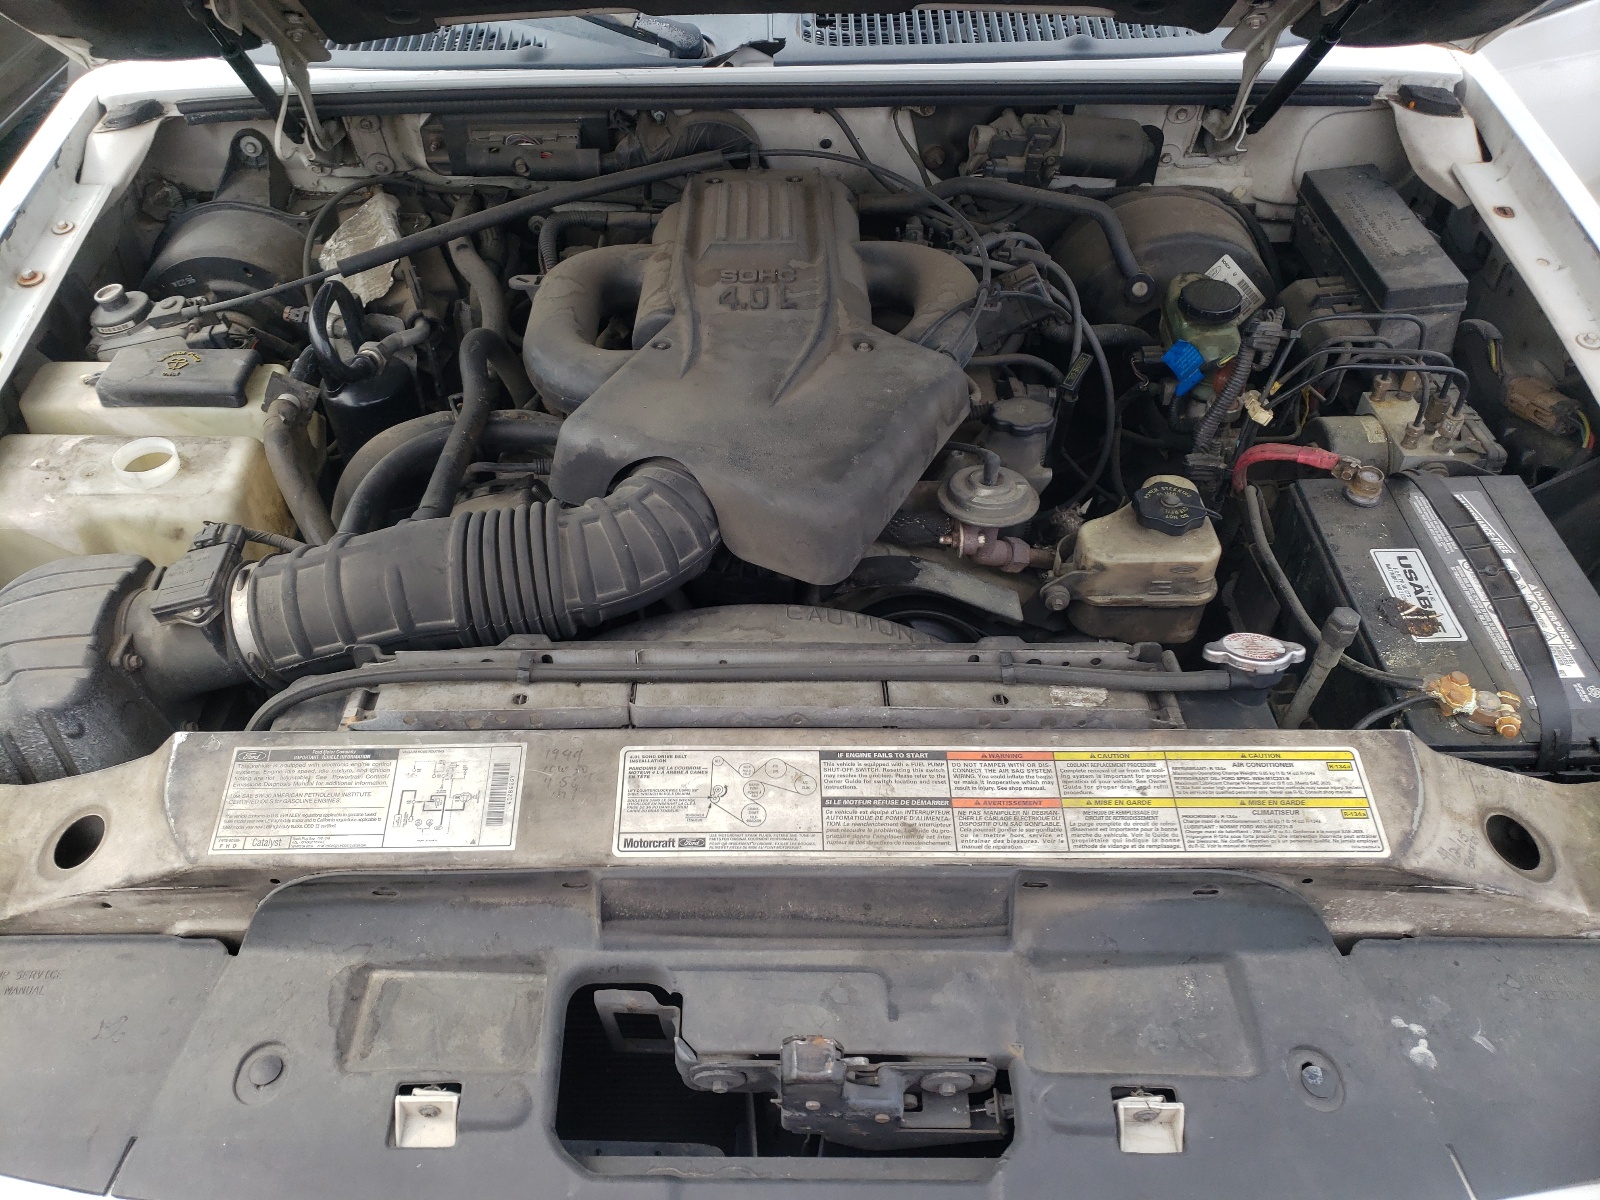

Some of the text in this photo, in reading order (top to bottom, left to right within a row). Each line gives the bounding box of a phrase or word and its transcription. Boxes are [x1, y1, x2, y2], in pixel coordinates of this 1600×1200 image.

[720, 269, 796, 284] SOHC
[786, 605, 914, 643] CAUTION
[243, 752, 260, 760] Ford
[252, 838, 282, 848] Catalyst
[623, 838, 675, 848] Motorcraft
[4, 986, 45, 995] MANUAL
